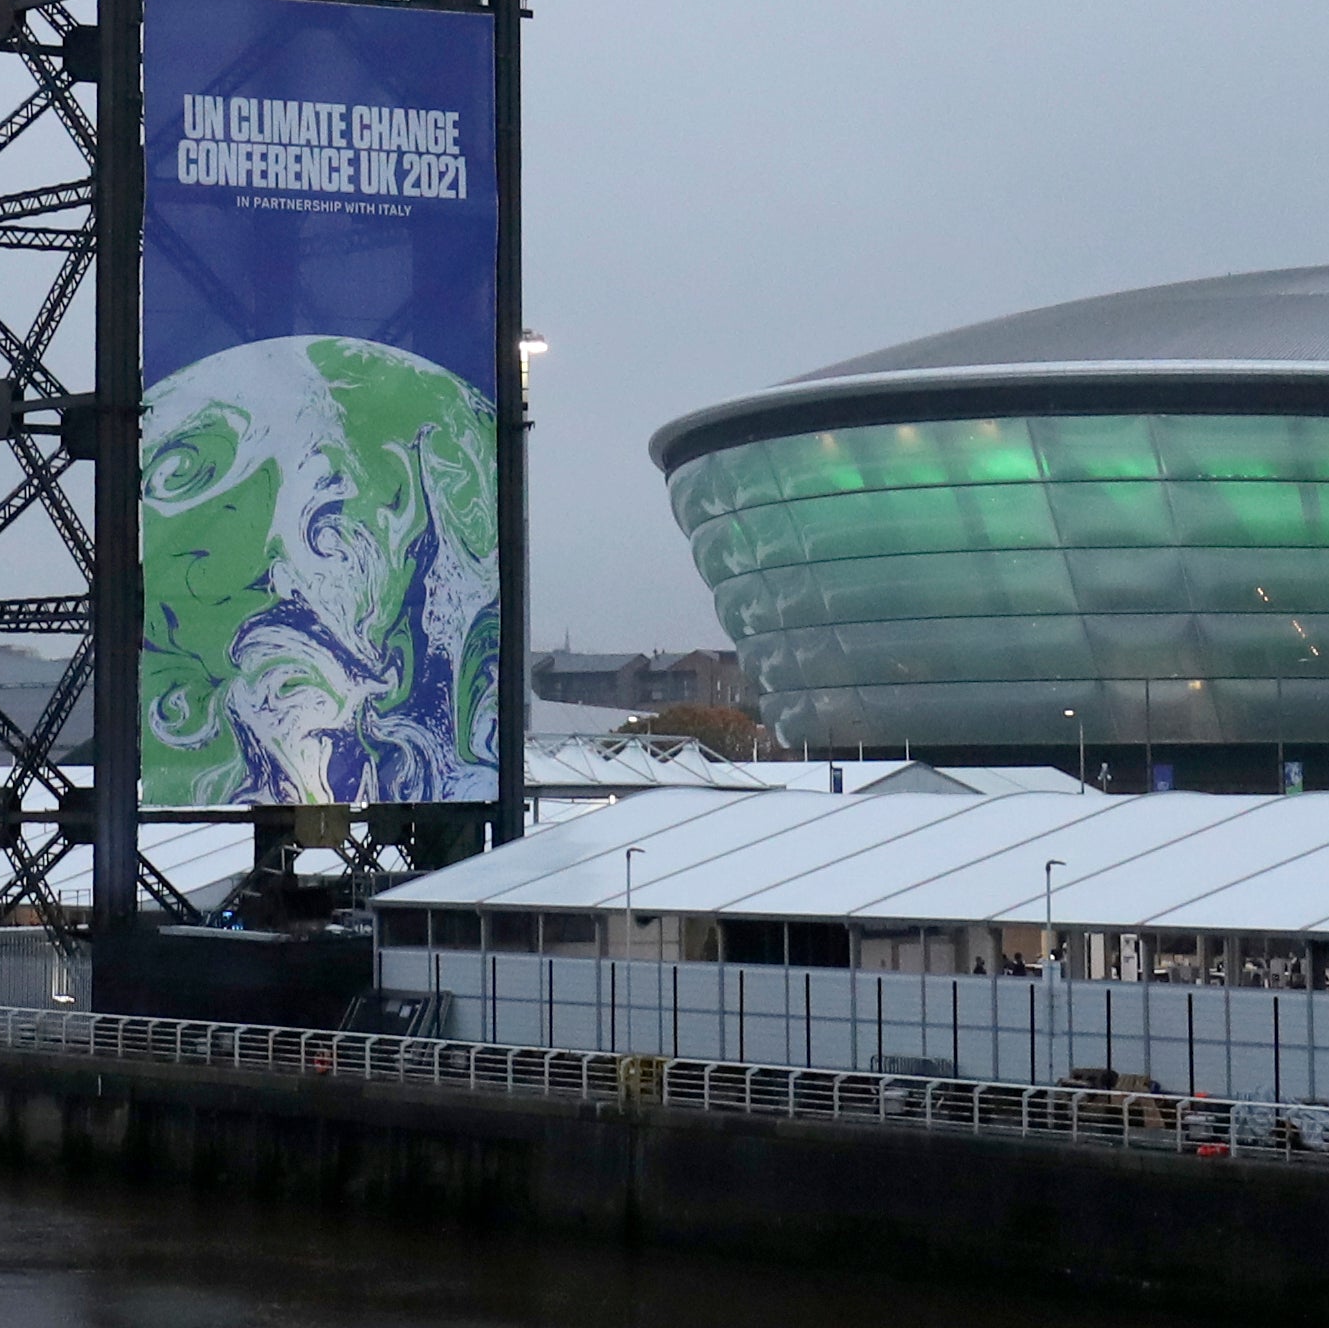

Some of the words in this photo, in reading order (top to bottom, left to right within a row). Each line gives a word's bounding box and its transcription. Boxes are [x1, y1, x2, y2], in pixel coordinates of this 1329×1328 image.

[184, 94, 225, 139] UN
[230, 97, 346, 148] CLIMATE
[352, 105, 460, 154] CHANGE
[177, 139, 355, 193] CONFERENCE
[359, 150, 398, 196] UK
[402, 154, 467, 199] 2021
[237, 196, 250, 208] IN
[254, 197, 342, 212] PARTNERSHIP
[345, 202, 375, 215] WITH
[379, 203, 412, 217] ITALY
